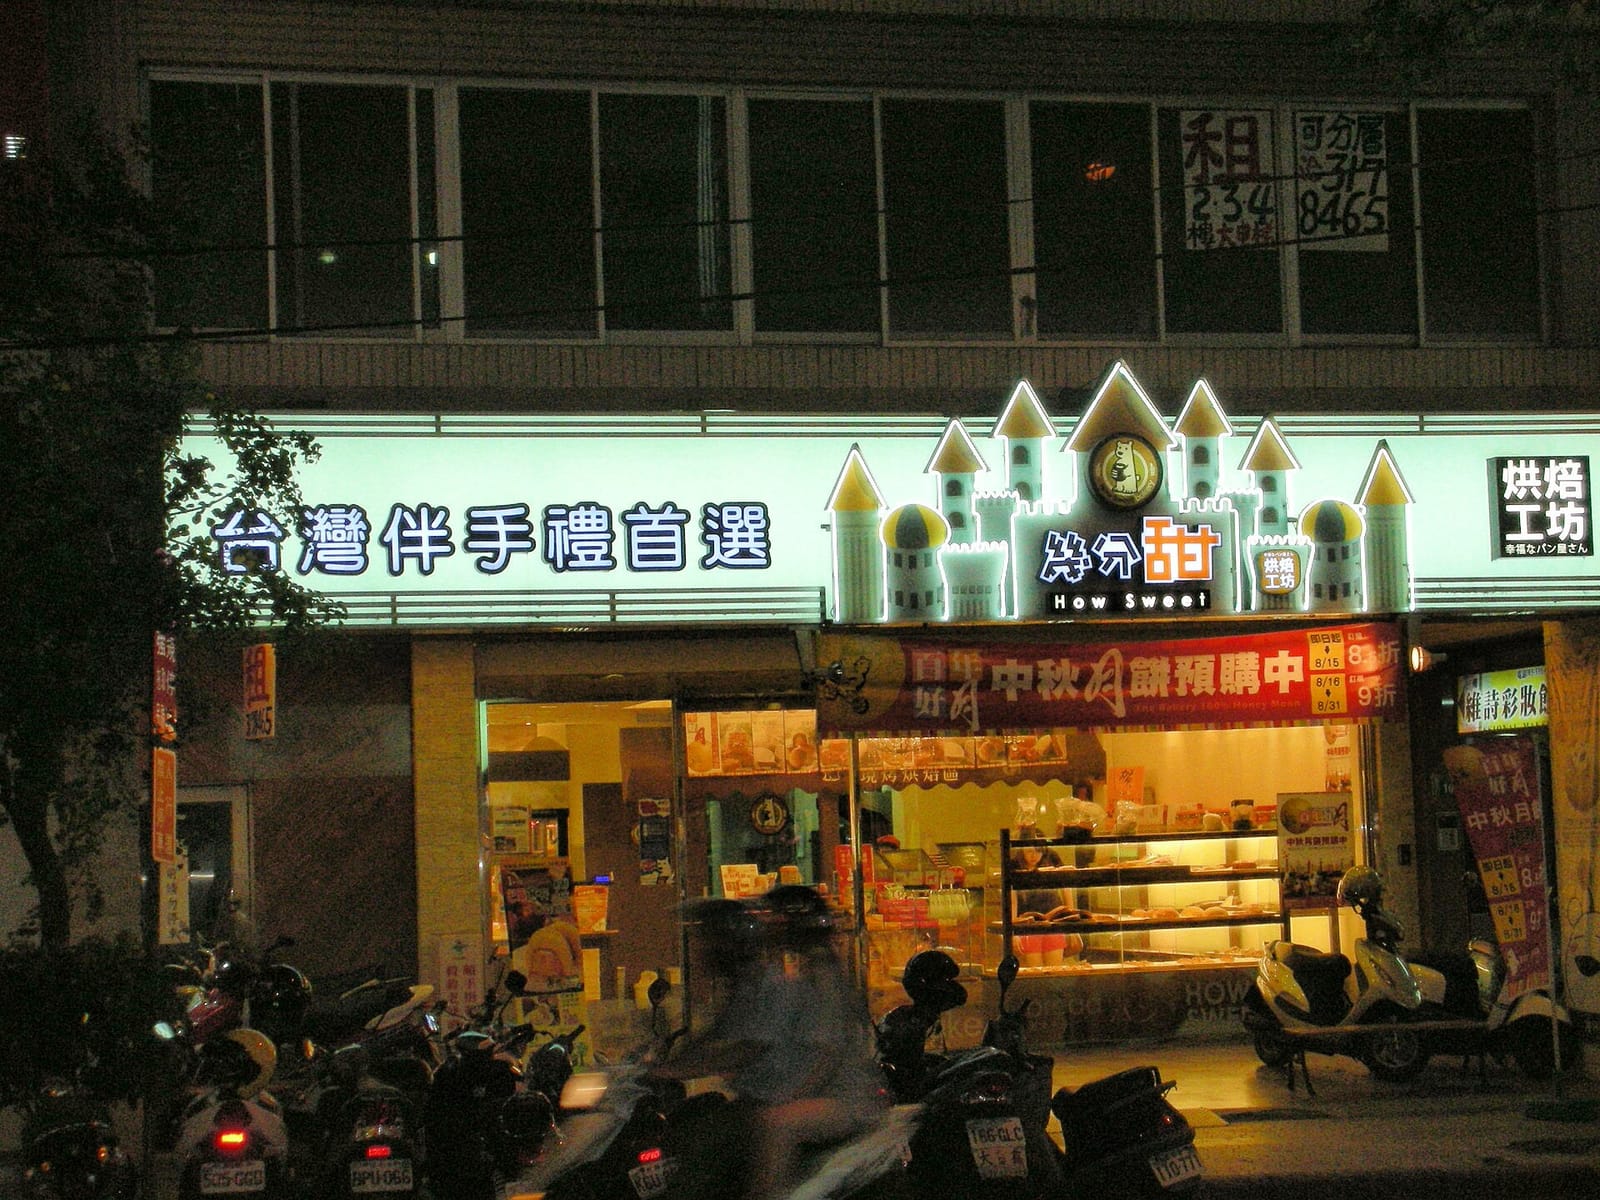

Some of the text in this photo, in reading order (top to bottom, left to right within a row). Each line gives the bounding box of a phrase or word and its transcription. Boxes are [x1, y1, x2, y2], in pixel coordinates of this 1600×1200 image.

[1183, 113, 1261, 183] 租
[1300, 190, 1388, 235] 8465
[1502, 459, 1584, 500] 烘焙
[210, 501, 772, 577] 台灣伴手禮首選
[1505, 501, 1585, 541] 工坊
[1039, 516, 1222, 584] 幾分甜
[1054, 592, 1206, 609] How Sweet
[1265, 573, 1295, 590] 工坊
[1315, 658, 1340, 668] 8/15
[1316, 677, 1341, 688] 8/16
[992, 649, 1305, 718] 中秋月餅預購中
[1357, 684, 1397, 708] 9折
[1317, 701, 1342, 711] 8/31
